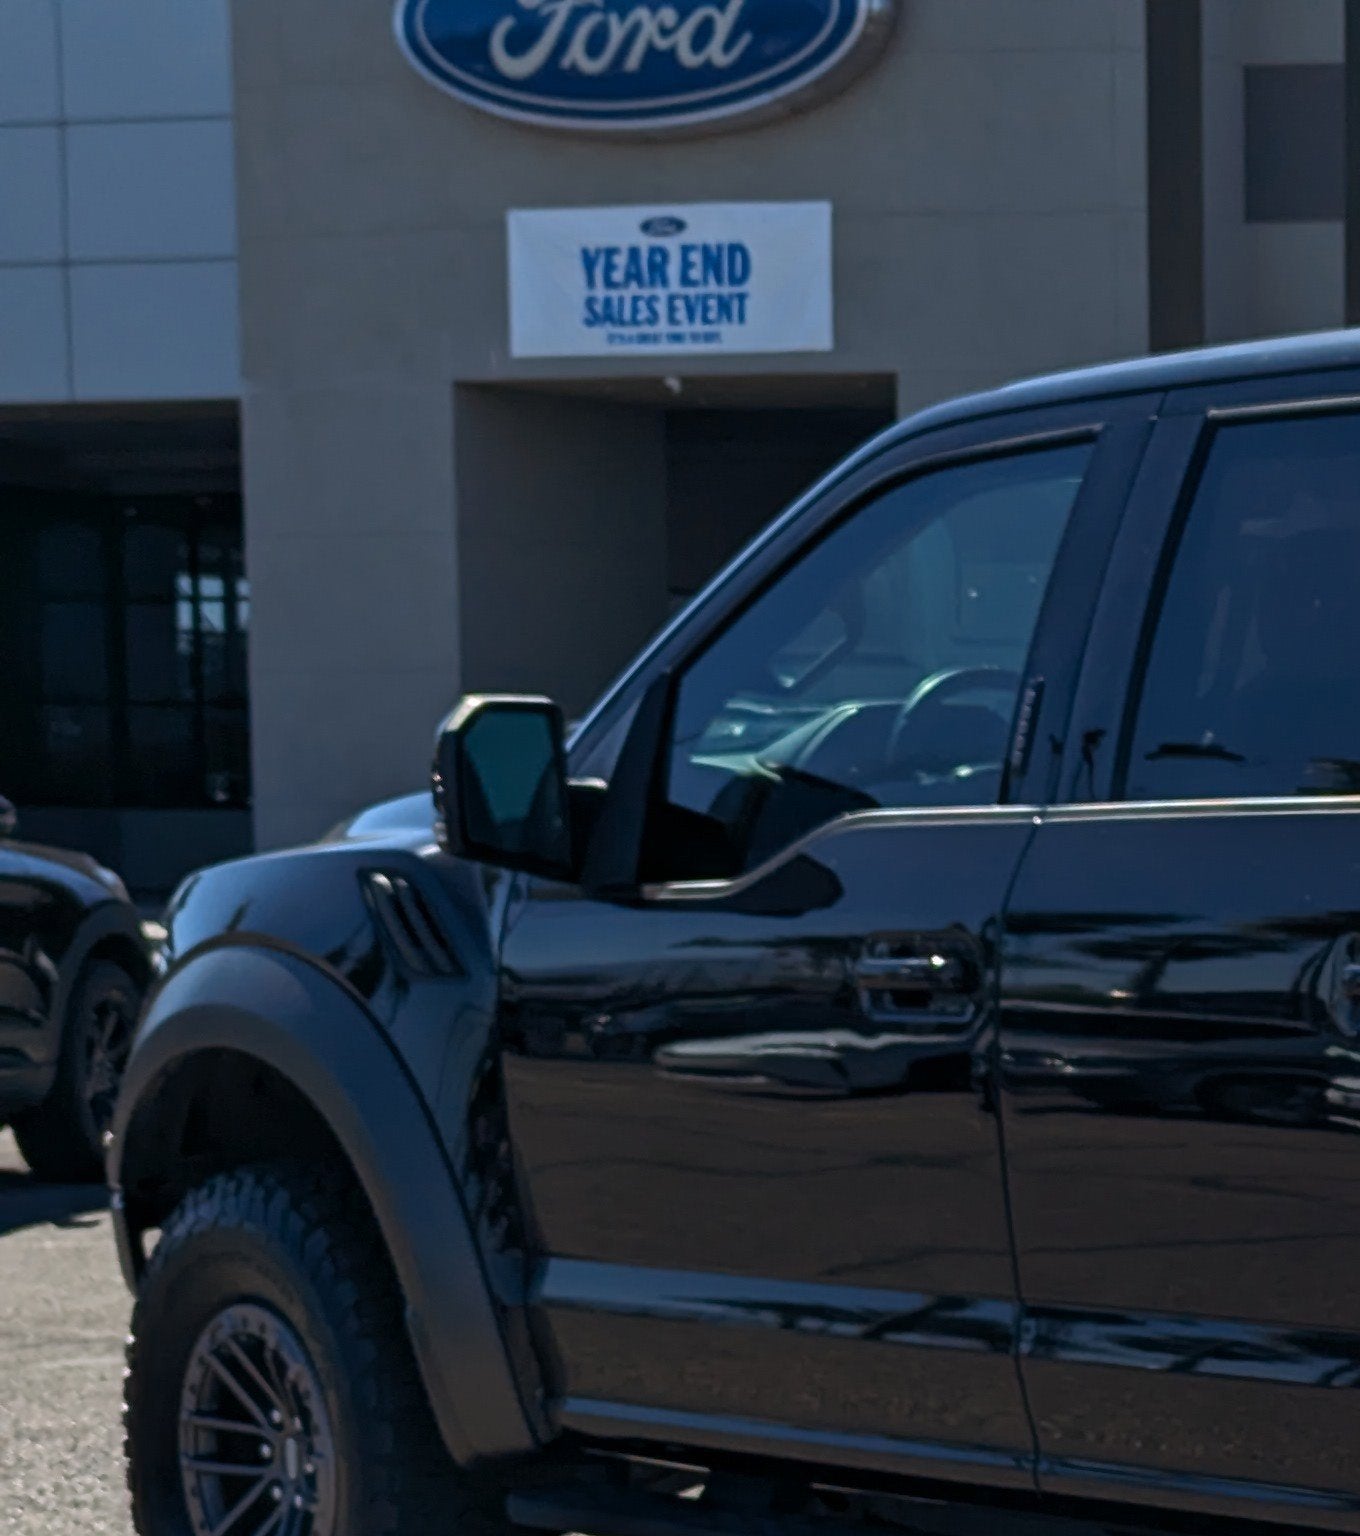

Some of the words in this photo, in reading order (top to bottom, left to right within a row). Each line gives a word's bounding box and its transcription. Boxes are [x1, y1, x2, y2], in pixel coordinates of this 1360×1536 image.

[489, 0, 752, 80] Ford
[579, 244, 669, 290] YEAR
[679, 242, 752, 287] END
[583, 294, 660, 327] SALES
[667, 291, 748, 325] EVENT
